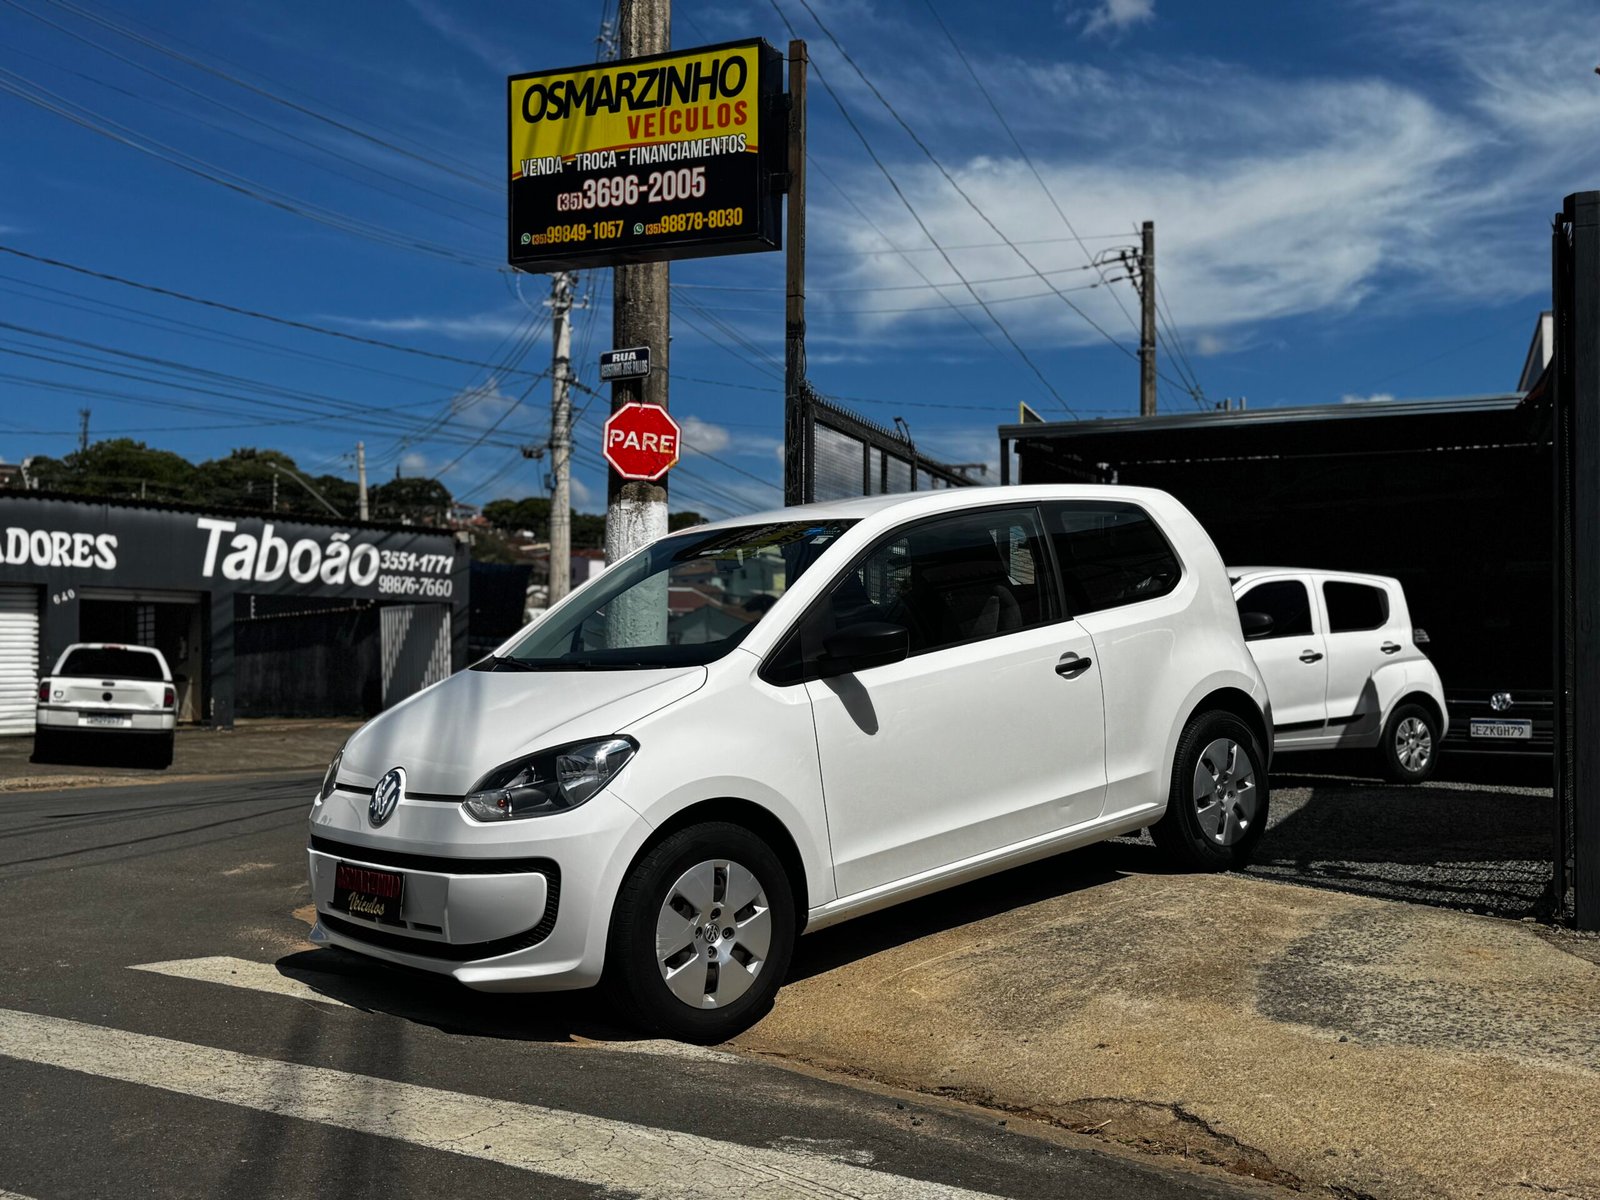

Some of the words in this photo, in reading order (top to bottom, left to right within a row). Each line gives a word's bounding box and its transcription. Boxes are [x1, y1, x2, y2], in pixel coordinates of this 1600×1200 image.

[522, 55, 748, 124] OSMARZINHO
[627, 100, 748, 139] VEÍCULOS
[521, 156, 563, 178] VENDA
[575, 150, 617, 172] TROCA
[628, 134, 747, 166] FINANCIAMENTOS
[612, 351, 637, 363] RUA
[608, 429, 675, 454] PARE
[197, 517, 380, 587] Taboão
